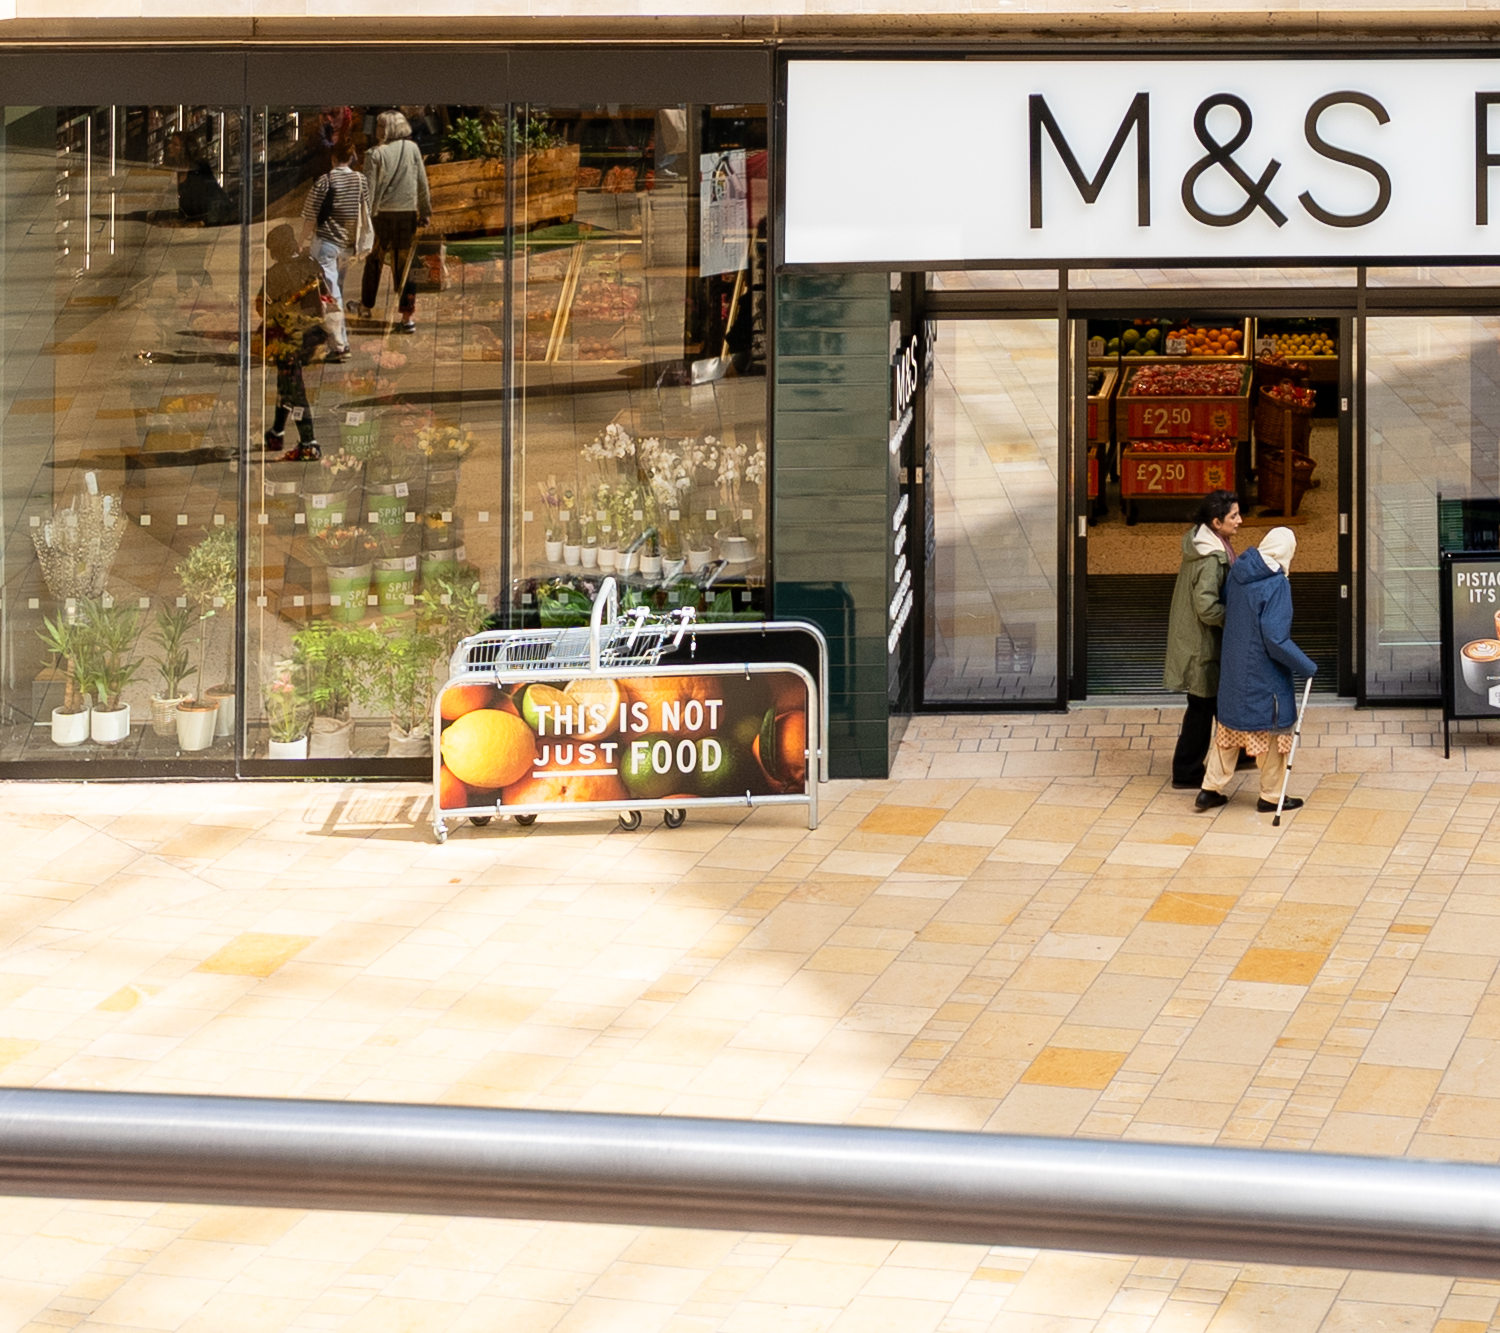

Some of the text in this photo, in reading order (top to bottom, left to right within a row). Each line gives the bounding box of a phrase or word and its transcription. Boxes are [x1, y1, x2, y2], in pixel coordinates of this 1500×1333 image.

[1029, 91, 1392, 229] M&S
[897, 335, 918, 421] M&S
[1143, 408, 1191, 434] £2.50
[1137, 464, 1185, 490] £2.50
[1469, 588, 1496, 603] IT'S
[533, 699, 723, 736] THIS IS NOT
[533, 738, 722, 774] JUST FOOD
